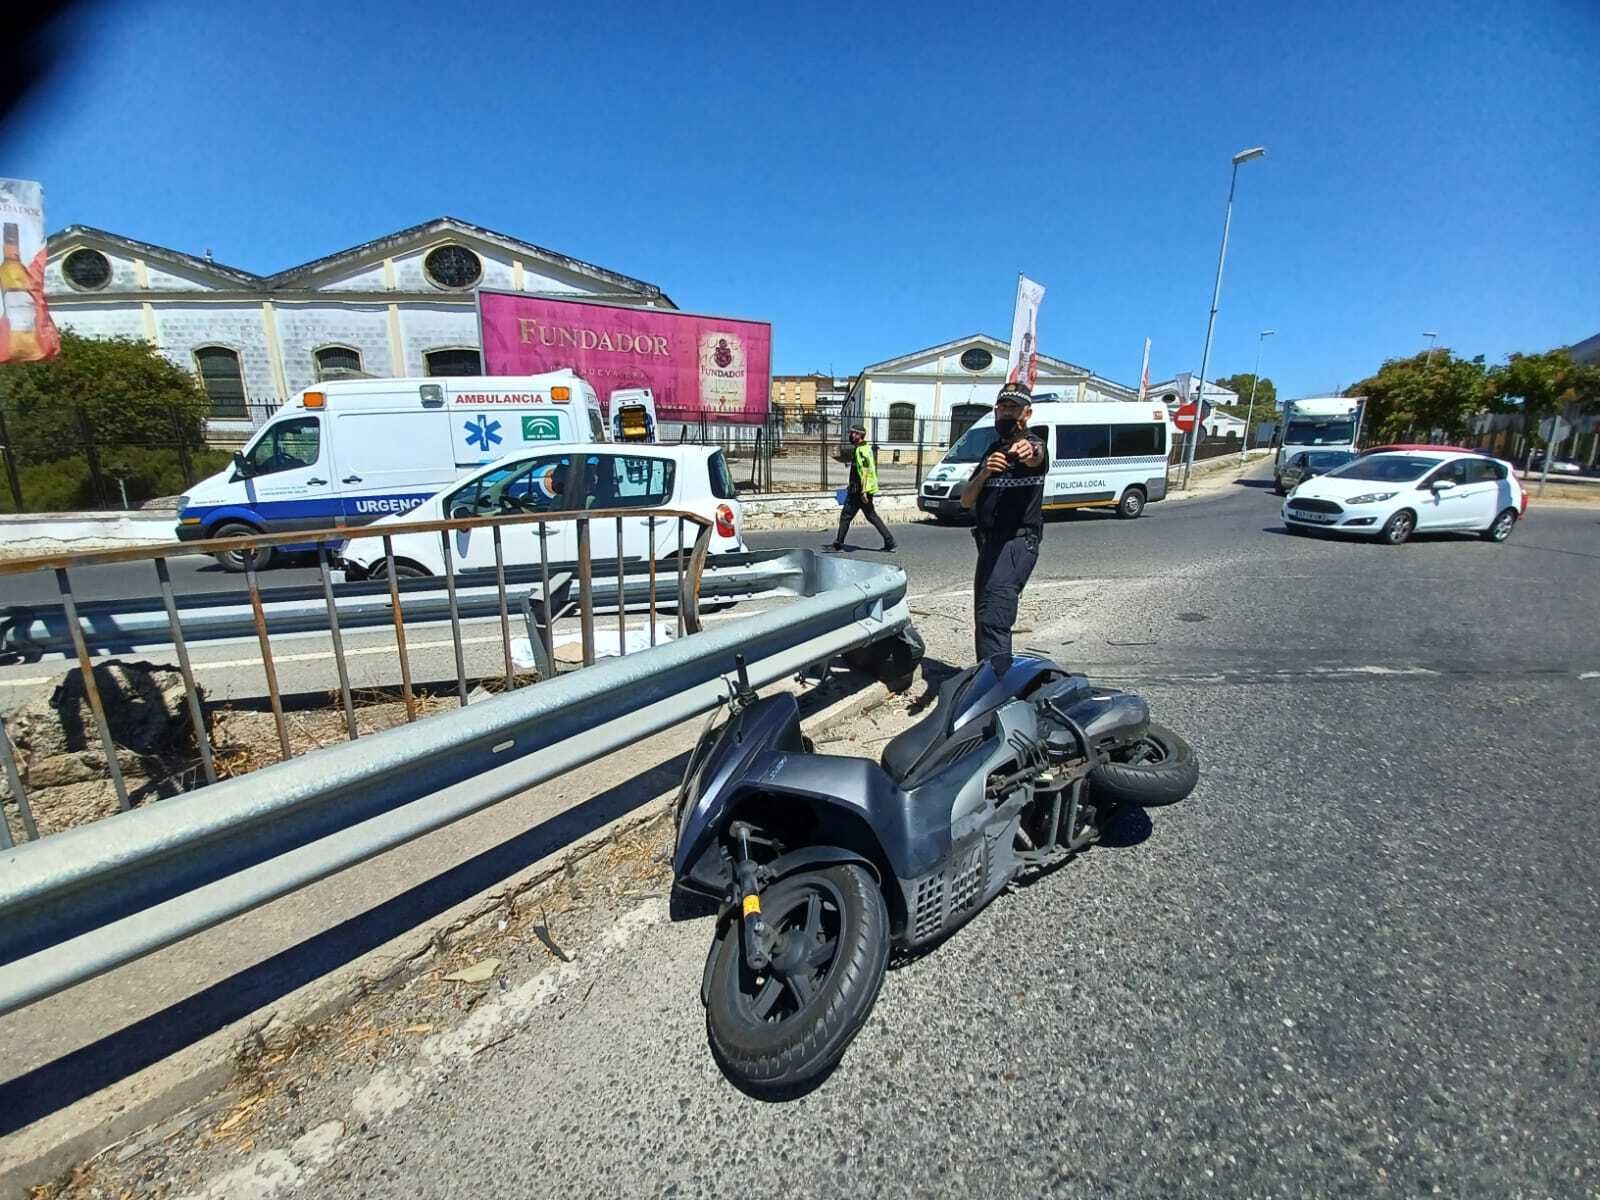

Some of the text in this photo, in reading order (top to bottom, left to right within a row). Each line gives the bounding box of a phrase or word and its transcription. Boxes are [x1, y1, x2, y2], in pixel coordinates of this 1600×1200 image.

[518, 318, 670, 357] FUNDADOR
[455, 393, 545, 404] AMBULANCIA
[1085, 479, 1106, 488] LOCAL
